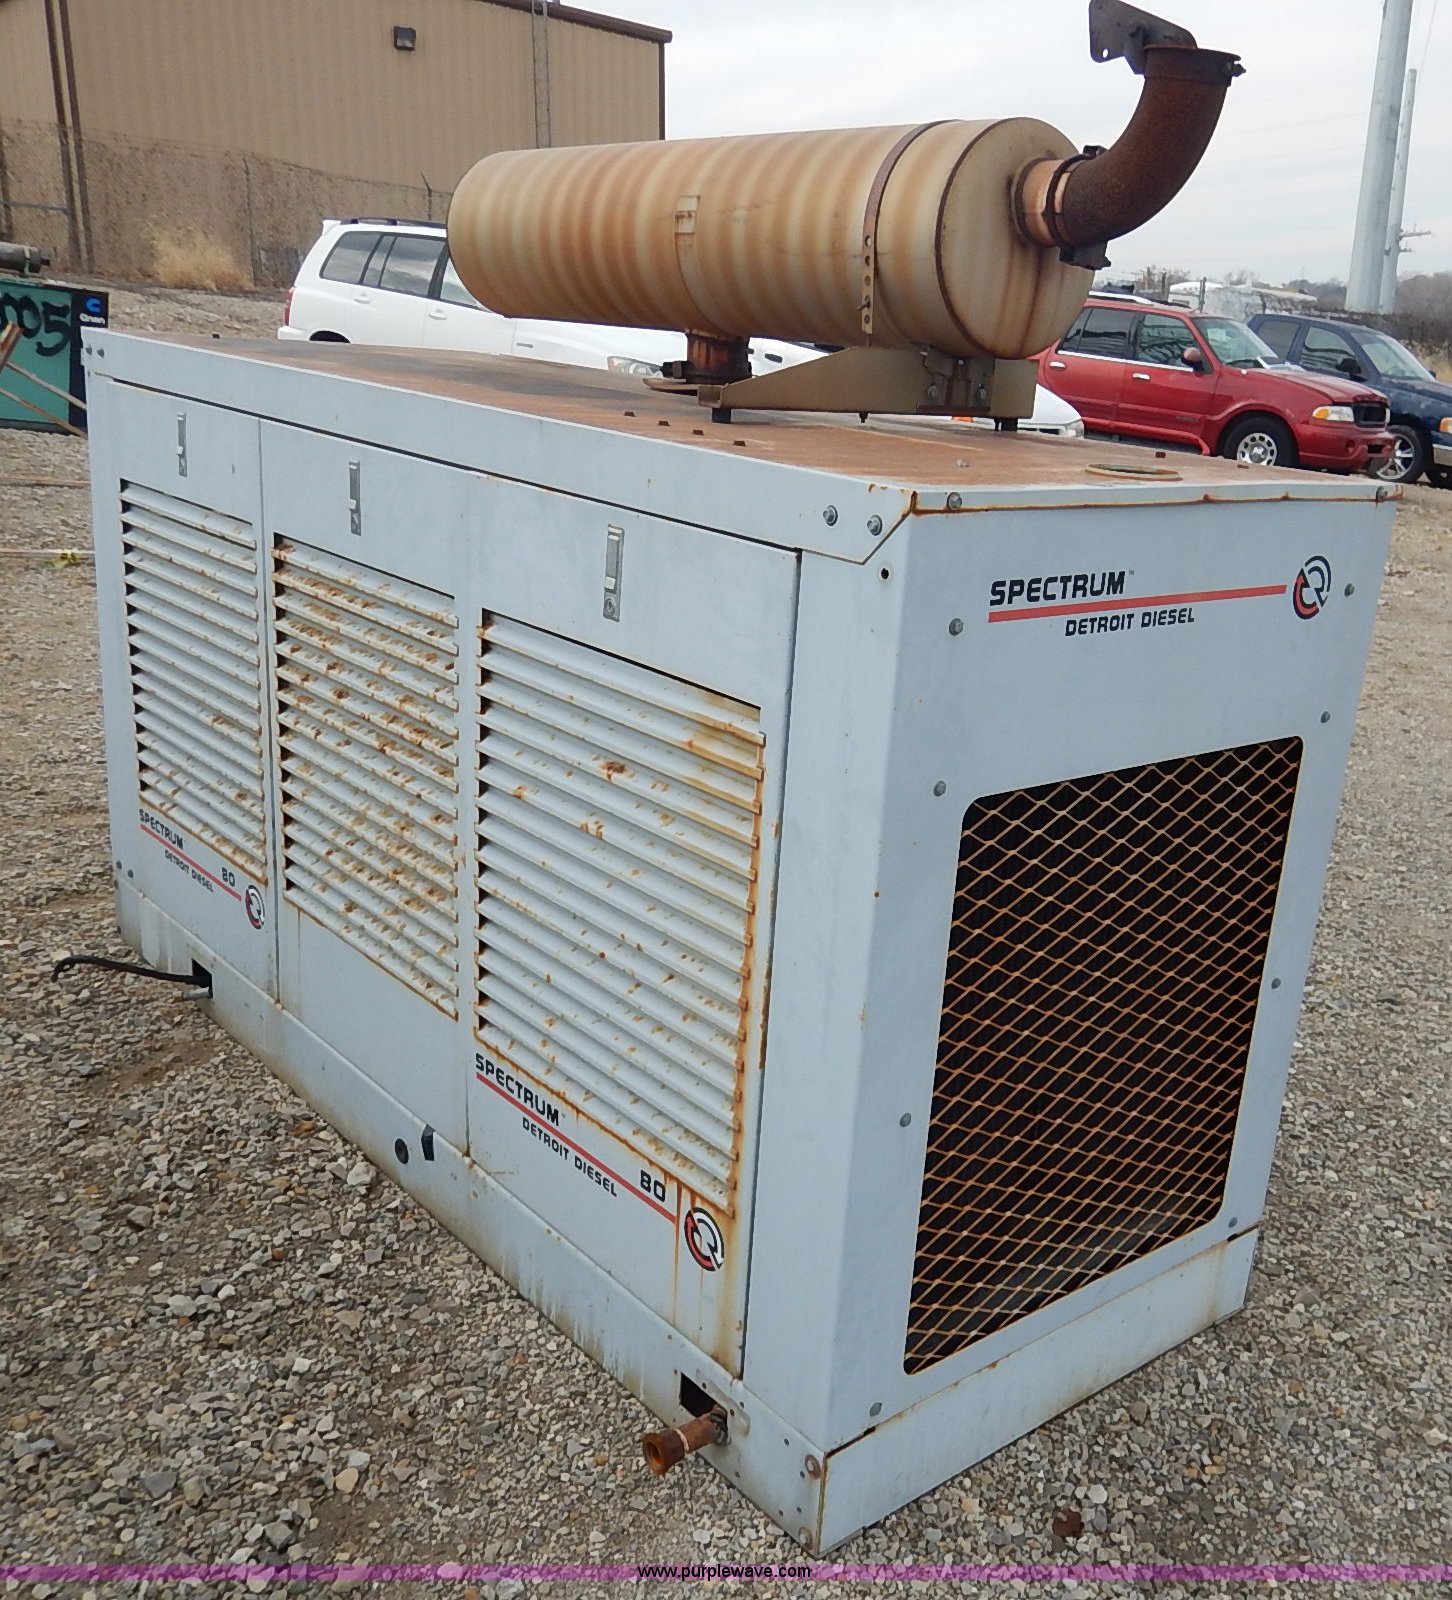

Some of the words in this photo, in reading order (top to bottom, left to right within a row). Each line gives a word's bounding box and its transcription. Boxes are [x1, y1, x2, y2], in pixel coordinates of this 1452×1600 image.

[989, 571, 1126, 607] SPECTRUM
[1064, 614, 1134, 637] DETROIT
[1141, 607, 1196, 627] DIESEL
[138, 808, 184, 850] SPECTRUM
[164, 849, 190, 875] DETROIT
[191, 868, 214, 893] DIESEL
[475, 1053, 560, 1127] SPECTRUM
[522, 1116, 570, 1160] DETROIT
[574, 1155, 618, 1198] DIESEL
